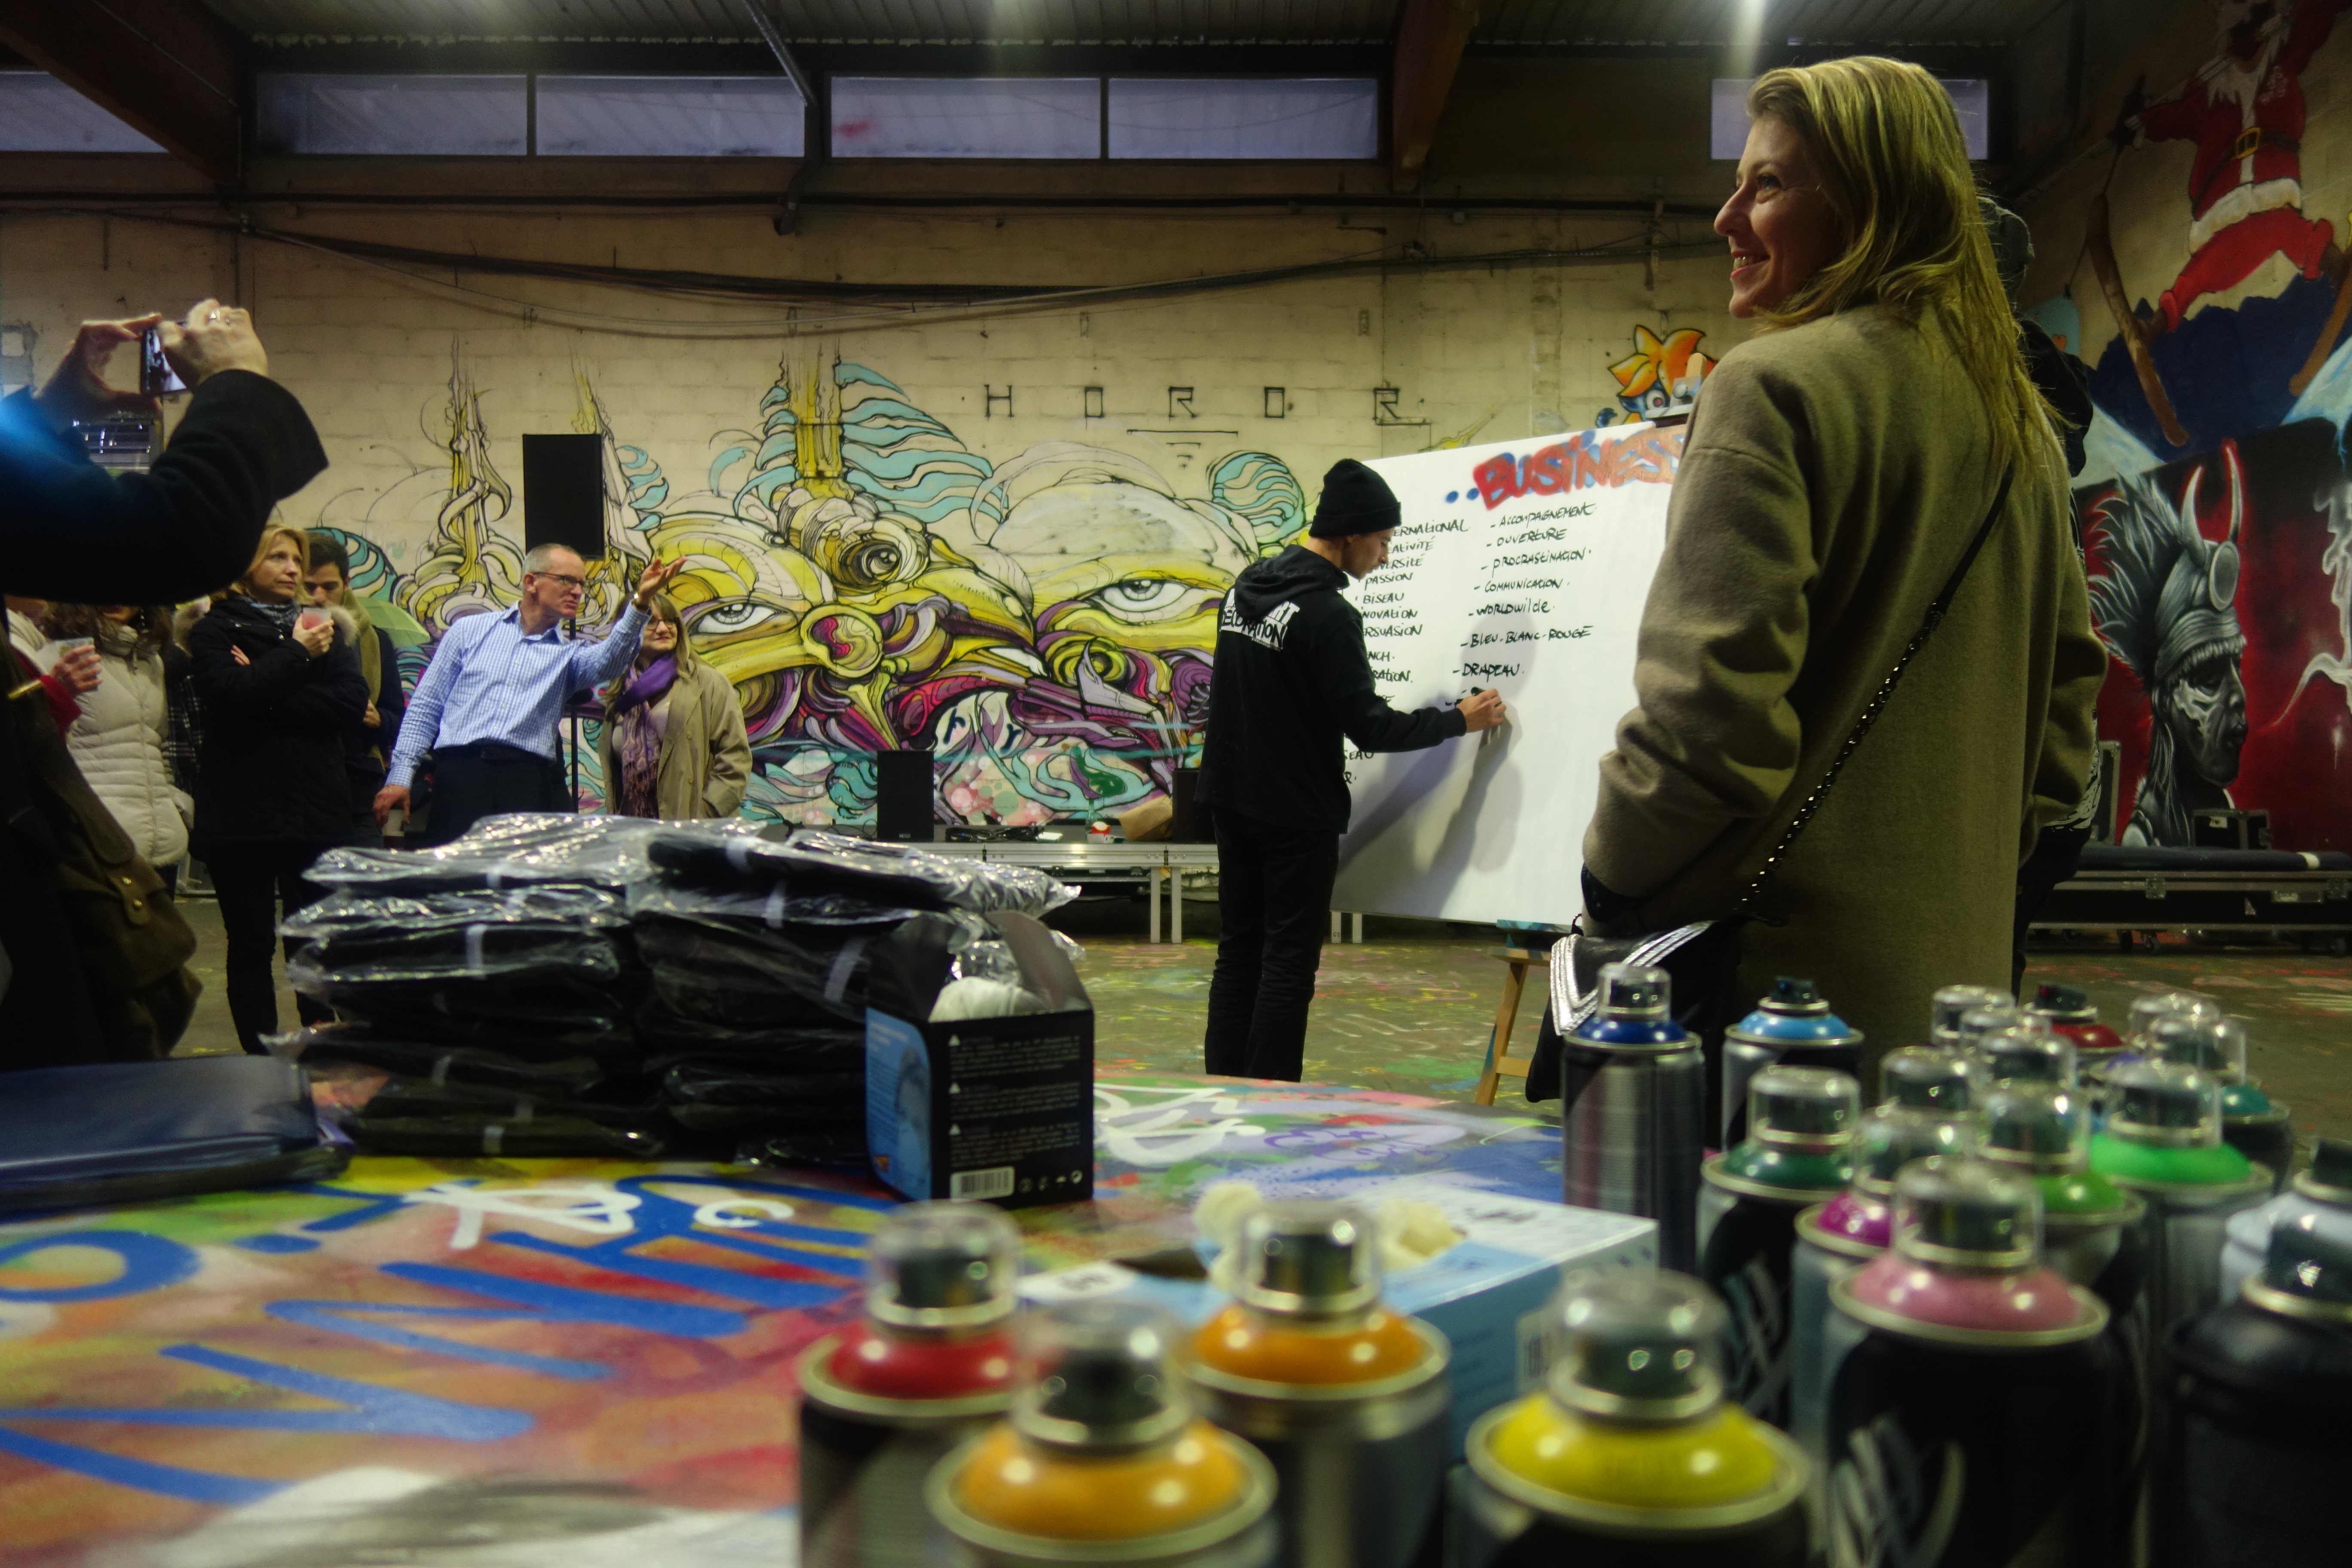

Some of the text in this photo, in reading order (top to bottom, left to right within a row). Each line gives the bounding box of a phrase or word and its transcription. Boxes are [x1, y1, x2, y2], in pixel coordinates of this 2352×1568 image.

[1388, 536, 1435, 554] EATIVITÉ
[1380, 553, 1425, 570] VERSITÉ
[1364, 572, 1413, 591] PASSION
[1363, 622, 1423, 637] ERSUASION
